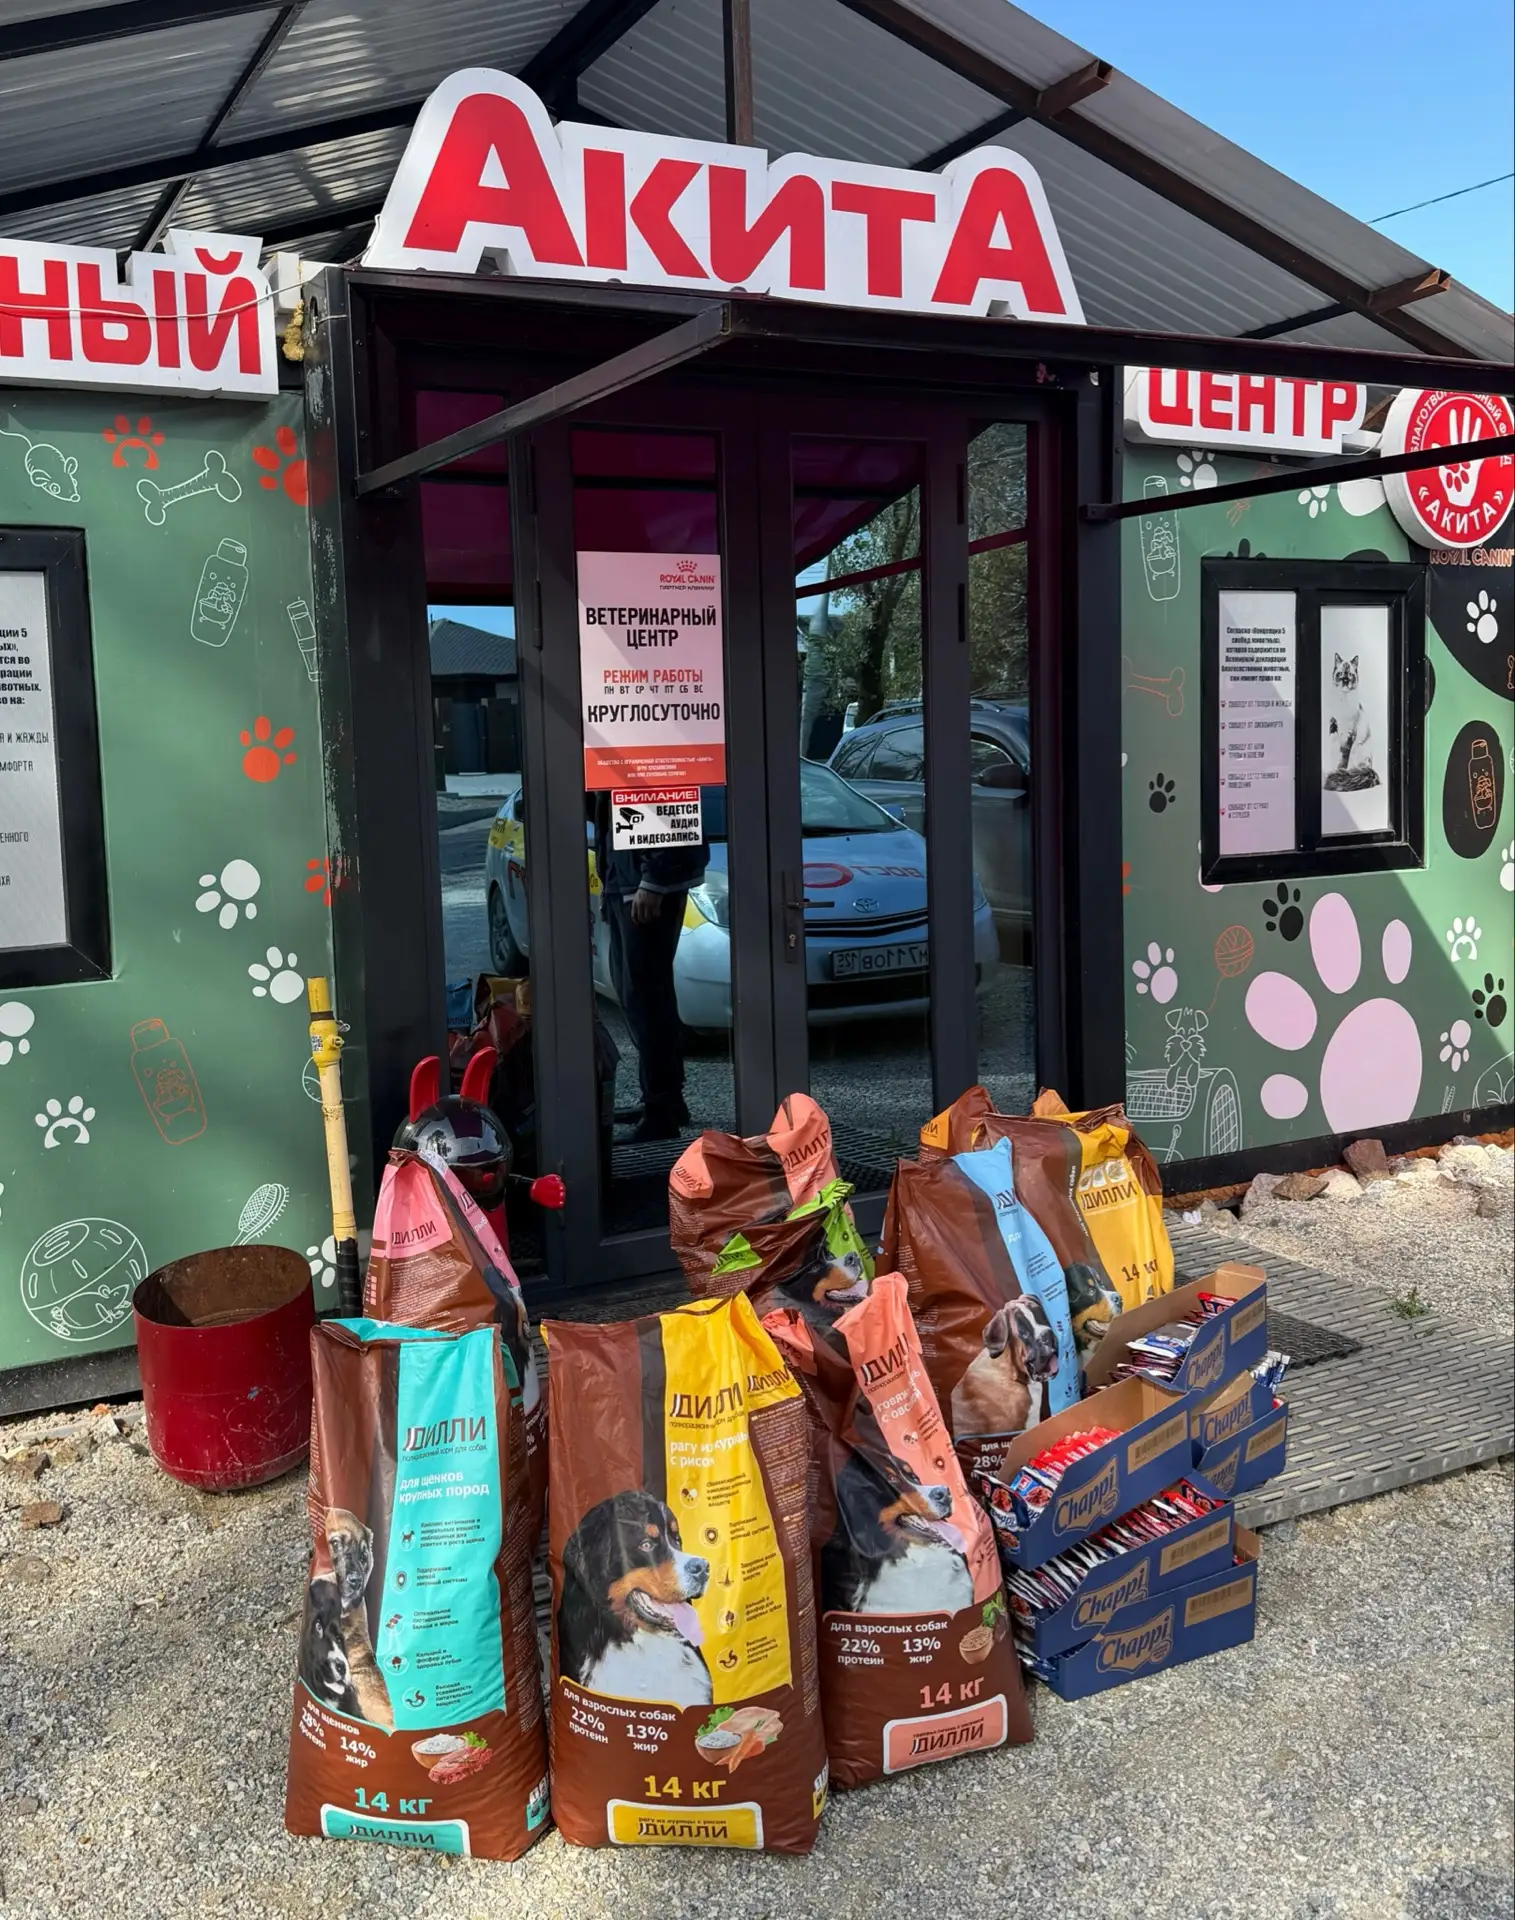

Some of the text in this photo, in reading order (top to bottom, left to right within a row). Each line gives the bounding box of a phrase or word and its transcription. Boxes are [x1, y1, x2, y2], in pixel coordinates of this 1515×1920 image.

[1147, 367, 1358, 440] ЦЕНТР
[1430, 549, 1470, 564] ROYAL
[660, 574, 715, 584] ROYAL CANIN
[586, 605, 717, 626] ВЕТЕРИНАРНЫЙ
[21, 628, 28, 638] 5
[627, 629, 678, 650] ЦЕНТР
[18, 656, 30, 664] во
[1, 669, 32, 679] рации
[604, 669, 703, 684] РЕЖИМ РАБОТЫ
[604, 685, 703, 694] ПН ВТ СР ЧТ ПТ СБ ВС
[10, 697, 25, 705] на:
[588, 703, 721, 723] КРУГЛОСУТОЧНО
[7, 732, 12, 742] И
[15, 732, 49, 743] ЖАЖДЫ
[615, 791, 697, 803] ВНИМАНИЕ!
[656, 804, 699, 816] ВЕДЕТСЯ
[671, 818, 699, 829] АУДИО
[629, 831, 700, 845] И ВИДЕОЗАПИСЬ
[1081, 1181, 1138, 1211] ДИЛЛИ
[391, 1221, 437, 1245] ДИЛЛИ
[1121, 1266, 1140, 1283] 14
[1188, 1336, 1223, 1388] Chappi
[1205, 1393, 1249, 1442] Chappi
[402, 1416, 486, 1451] ДИЛЛИ
[670, 1441, 697, 1454] рагу
[981, 1442, 999, 1452] для
[670, 1456, 676, 1465] с
[400, 1471, 464, 1491] для щенков
[399, 1484, 490, 1505] крупных пород
[1055, 1467, 1115, 1532] Chappi
[1078, 1567, 1145, 1625] Chappi
[831, 1620, 948, 1635] для взрослых собак
[841, 1637, 941, 1654] 22% 13%
[1100, 1615, 1171, 1668] Chappi
[838, 1655, 933, 1666] протеин жир
[920, 1676, 985, 1708] 14 кг
[564, 1688, 676, 1722] для взрослых собак
[302, 1707, 376, 1759] 28% 14%
[321, 1712, 360, 1736] щенков
[571, 1706, 669, 1741] 22% 13%
[569, 1721, 659, 1754] протеин жир
[909, 1723, 984, 1756] ДИЛЛИ
[345, 1754, 368, 1768] жир
[644, 1775, 726, 1798] 14 кг
[354, 1787, 433, 1814] 14 кг
[350, 1825, 435, 1845] ДИЛЛИ
[638, 1822, 728, 1838] ДИЛЛИ
